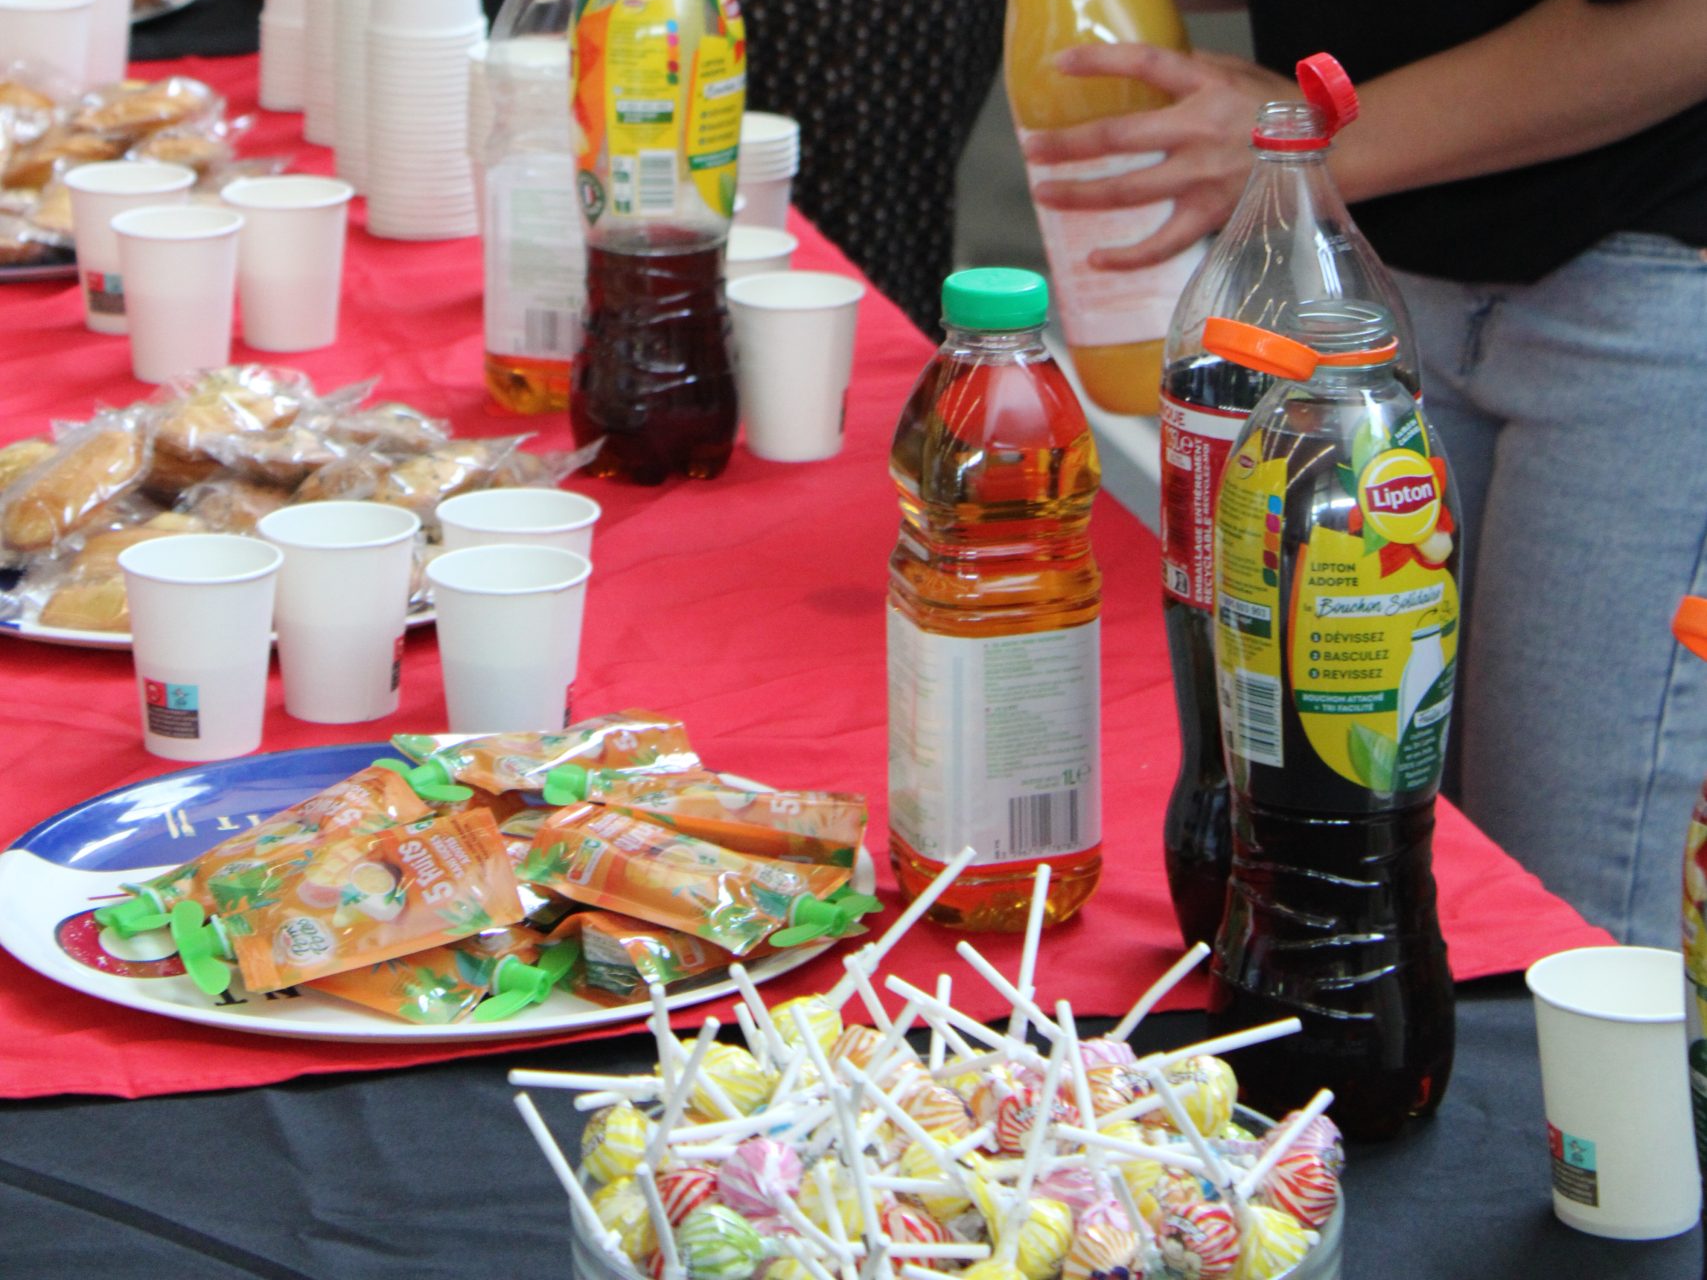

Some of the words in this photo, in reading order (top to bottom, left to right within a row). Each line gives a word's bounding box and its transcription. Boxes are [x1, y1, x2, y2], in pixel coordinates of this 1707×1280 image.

[1194, 437, 1203, 525] ENTIÈREMENT
[1372, 483, 1433, 510] Lipton
[1194, 527, 1204, 602] EMBALLAGE
[1203, 517, 1213, 605] RECYCLABLE
[1310, 562, 1357, 573] LIPTON
[1308, 576, 1359, 587] ADOPTE
[1315, 597, 1384, 618] Bouchon
[1324, 632, 1385, 644] DÉVISSEZ
[1323, 650, 1390, 662] BASCULEZ
[1322, 669, 1383, 680] REVISSEZ
